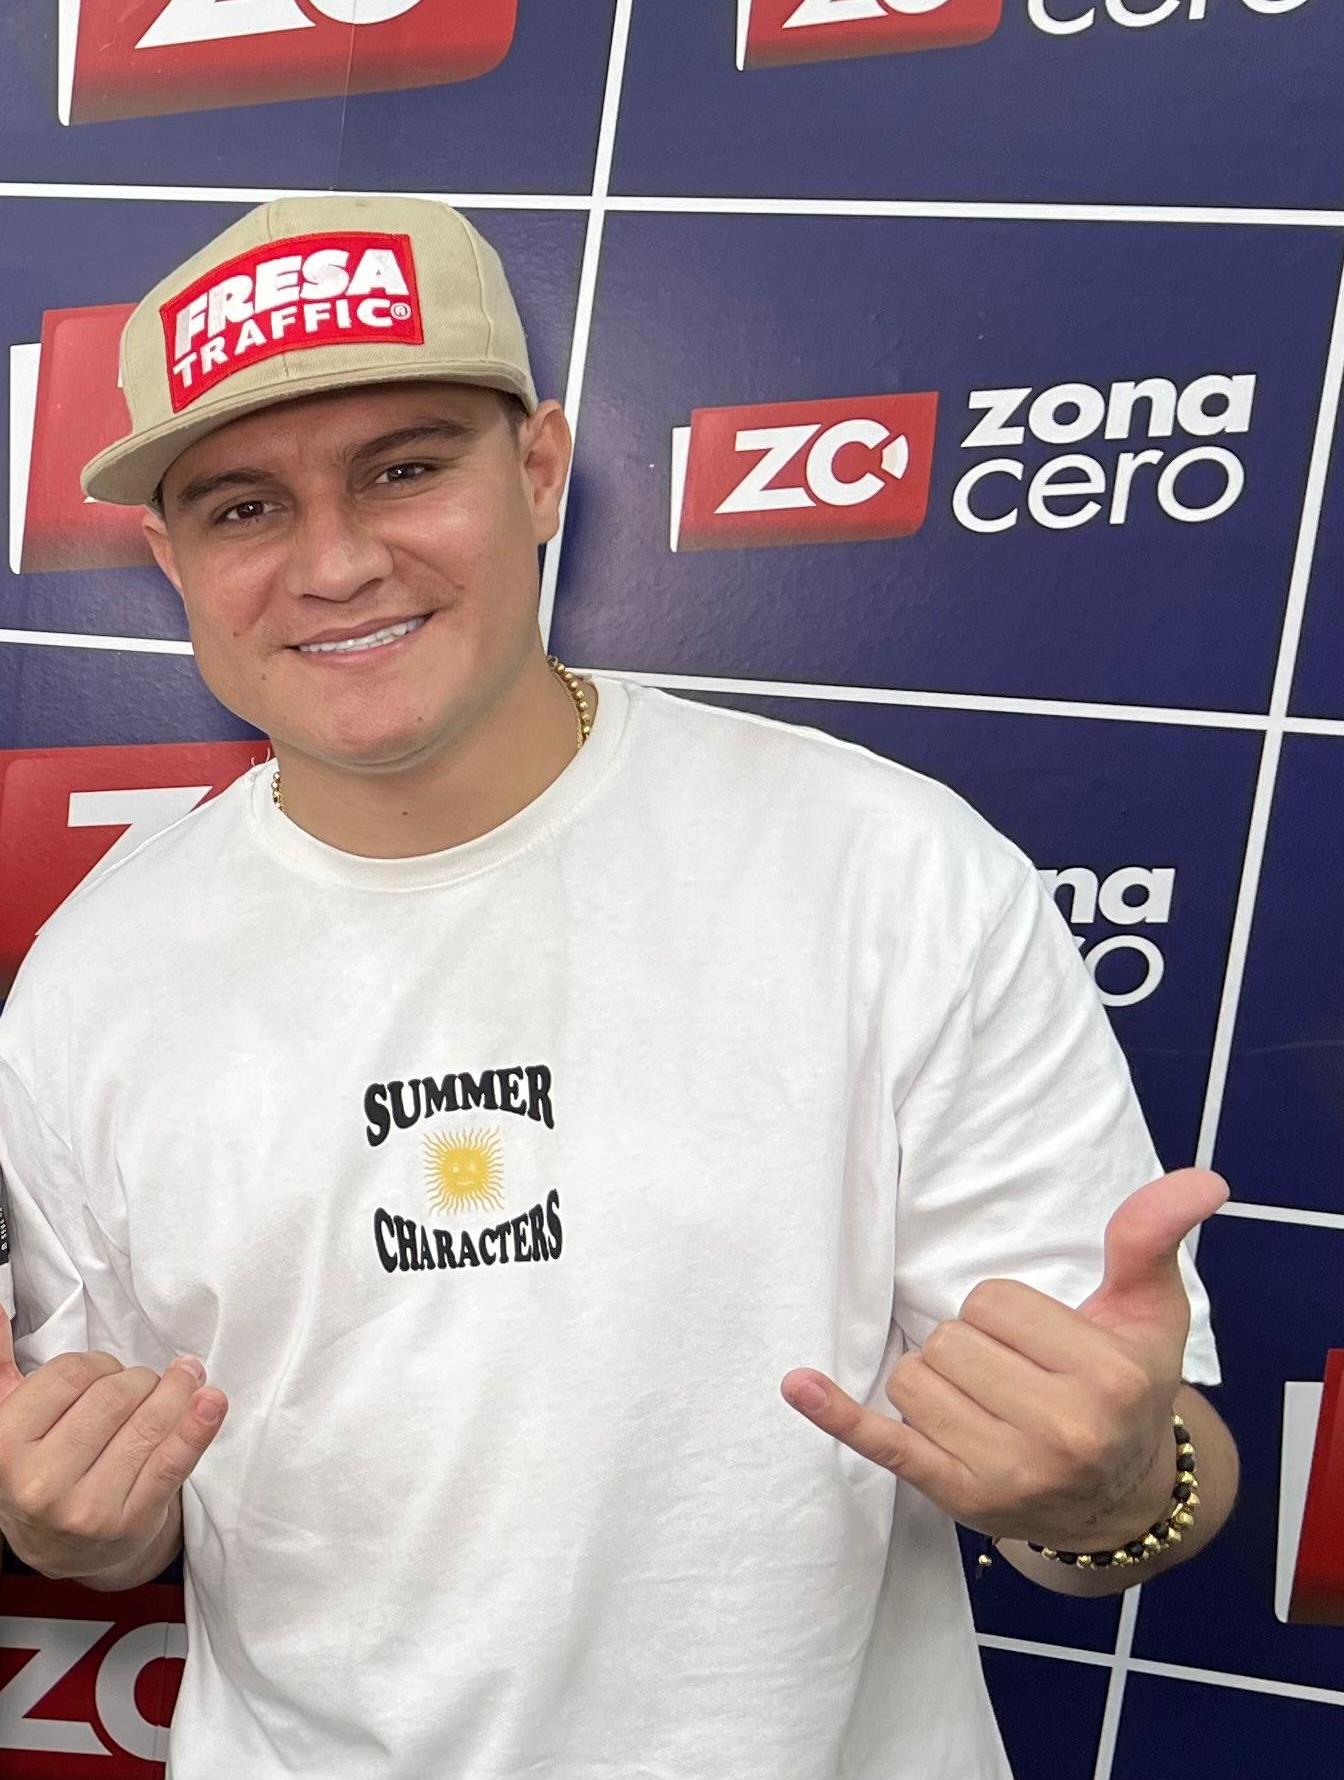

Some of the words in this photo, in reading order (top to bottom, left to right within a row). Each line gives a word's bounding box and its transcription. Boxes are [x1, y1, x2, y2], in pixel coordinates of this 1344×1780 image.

[174, 248, 410, 361] FRESA
[960, 373, 1256, 448] zona
[952, 446, 1244, 533] cero
[1037, 866, 1176, 926] na
[363, 1064, 555, 1147] SUMMER
[373, 1188, 563, 1273] CHARACTERS
